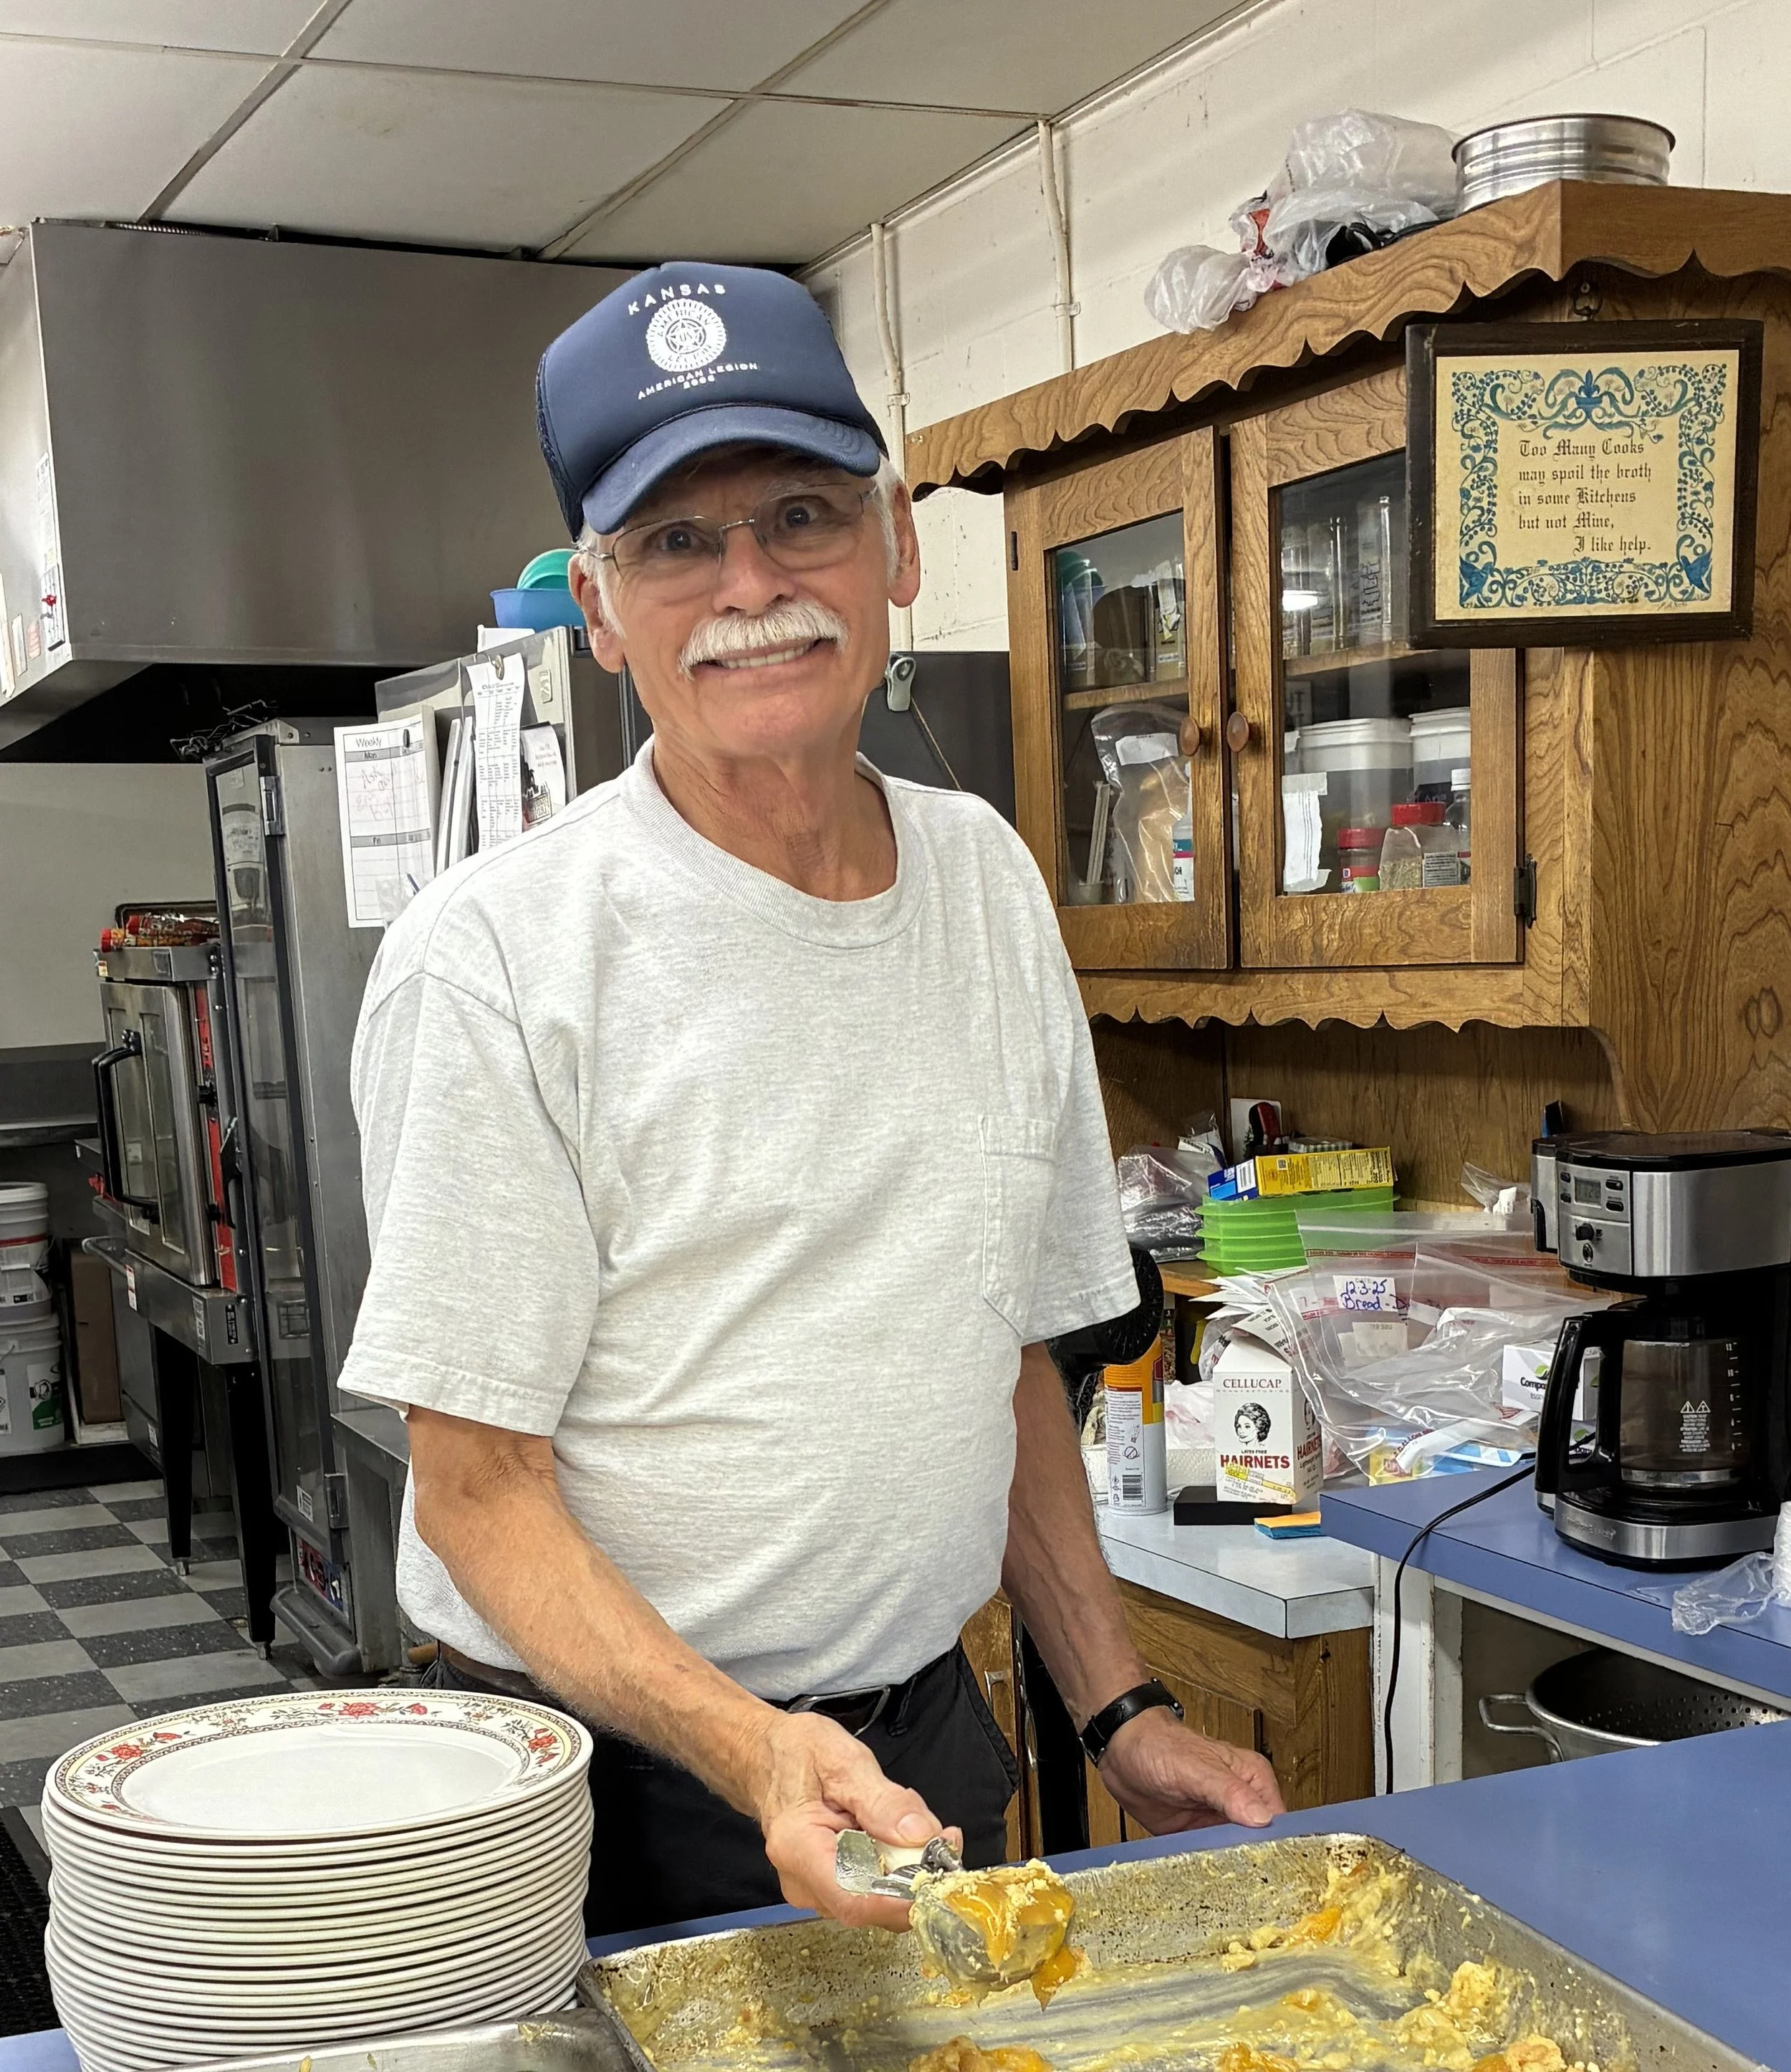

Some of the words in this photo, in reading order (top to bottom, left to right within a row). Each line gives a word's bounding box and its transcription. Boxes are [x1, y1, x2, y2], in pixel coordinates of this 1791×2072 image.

[628, 283, 726, 315] KANSAS
[638, 369, 704, 400] AMERICAN
[709, 363, 758, 375] LEGION
[1519, 440, 1547, 457] Too
[1553, 439, 1595, 461] Many
[1602, 438, 1644, 455] Cooks
[1519, 470, 1545, 486] may
[1552, 464, 1584, 484] spoil
[1591, 464, 1610, 484] the
[1617, 463, 1651, 482] broth
[1519, 491, 1531, 505] in
[1537, 494, 1570, 504] some
[1576, 487, 1636, 509] Kitchens
[1519, 514, 1540, 529] but
[1546, 514, 1567, 529] not
[1573, 512, 1614, 533] Mine,
[1573, 536, 1585, 556] I
[1591, 537, 1614, 552] like
[1620, 535, 1651, 555] help.
[1340, 1292, 1383, 1310] Bread
[1223, 1378, 1282, 1388] CELLUCAP
[1220, 1454, 1290, 1469] HAIRNETS
